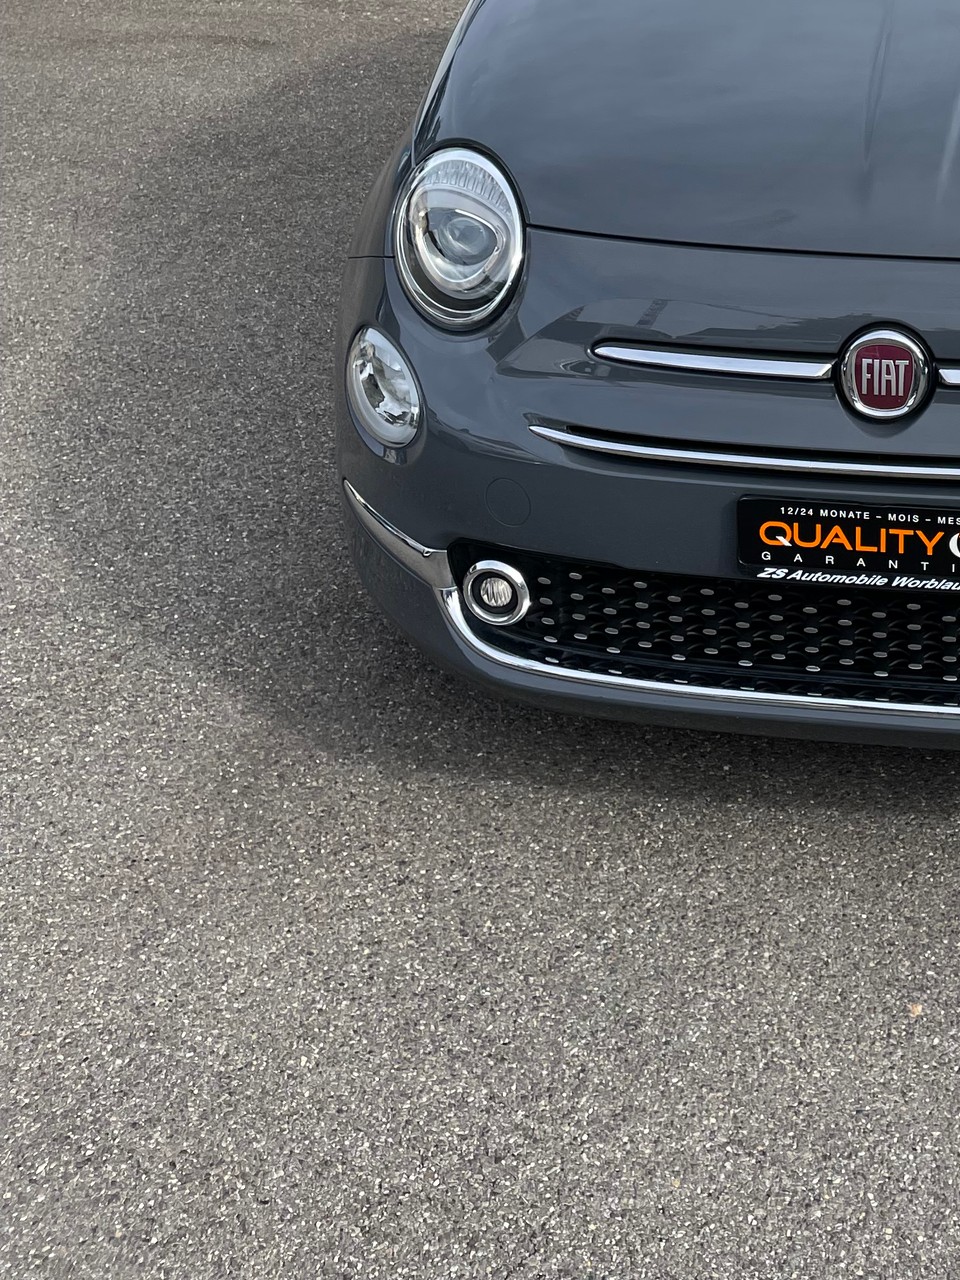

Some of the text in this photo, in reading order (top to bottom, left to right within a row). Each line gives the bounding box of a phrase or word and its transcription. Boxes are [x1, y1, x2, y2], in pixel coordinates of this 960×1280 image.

[861, 358, 909, 396] FIAT
[780, 507, 814, 517] 12/24
[820, 508, 871, 520] MONATE
[888, 513, 920, 523] MOIS
[759, 520, 945, 556] QUALITY
[756, 567, 789, 579] ZS
[786, 569, 889, 587] Automobile
